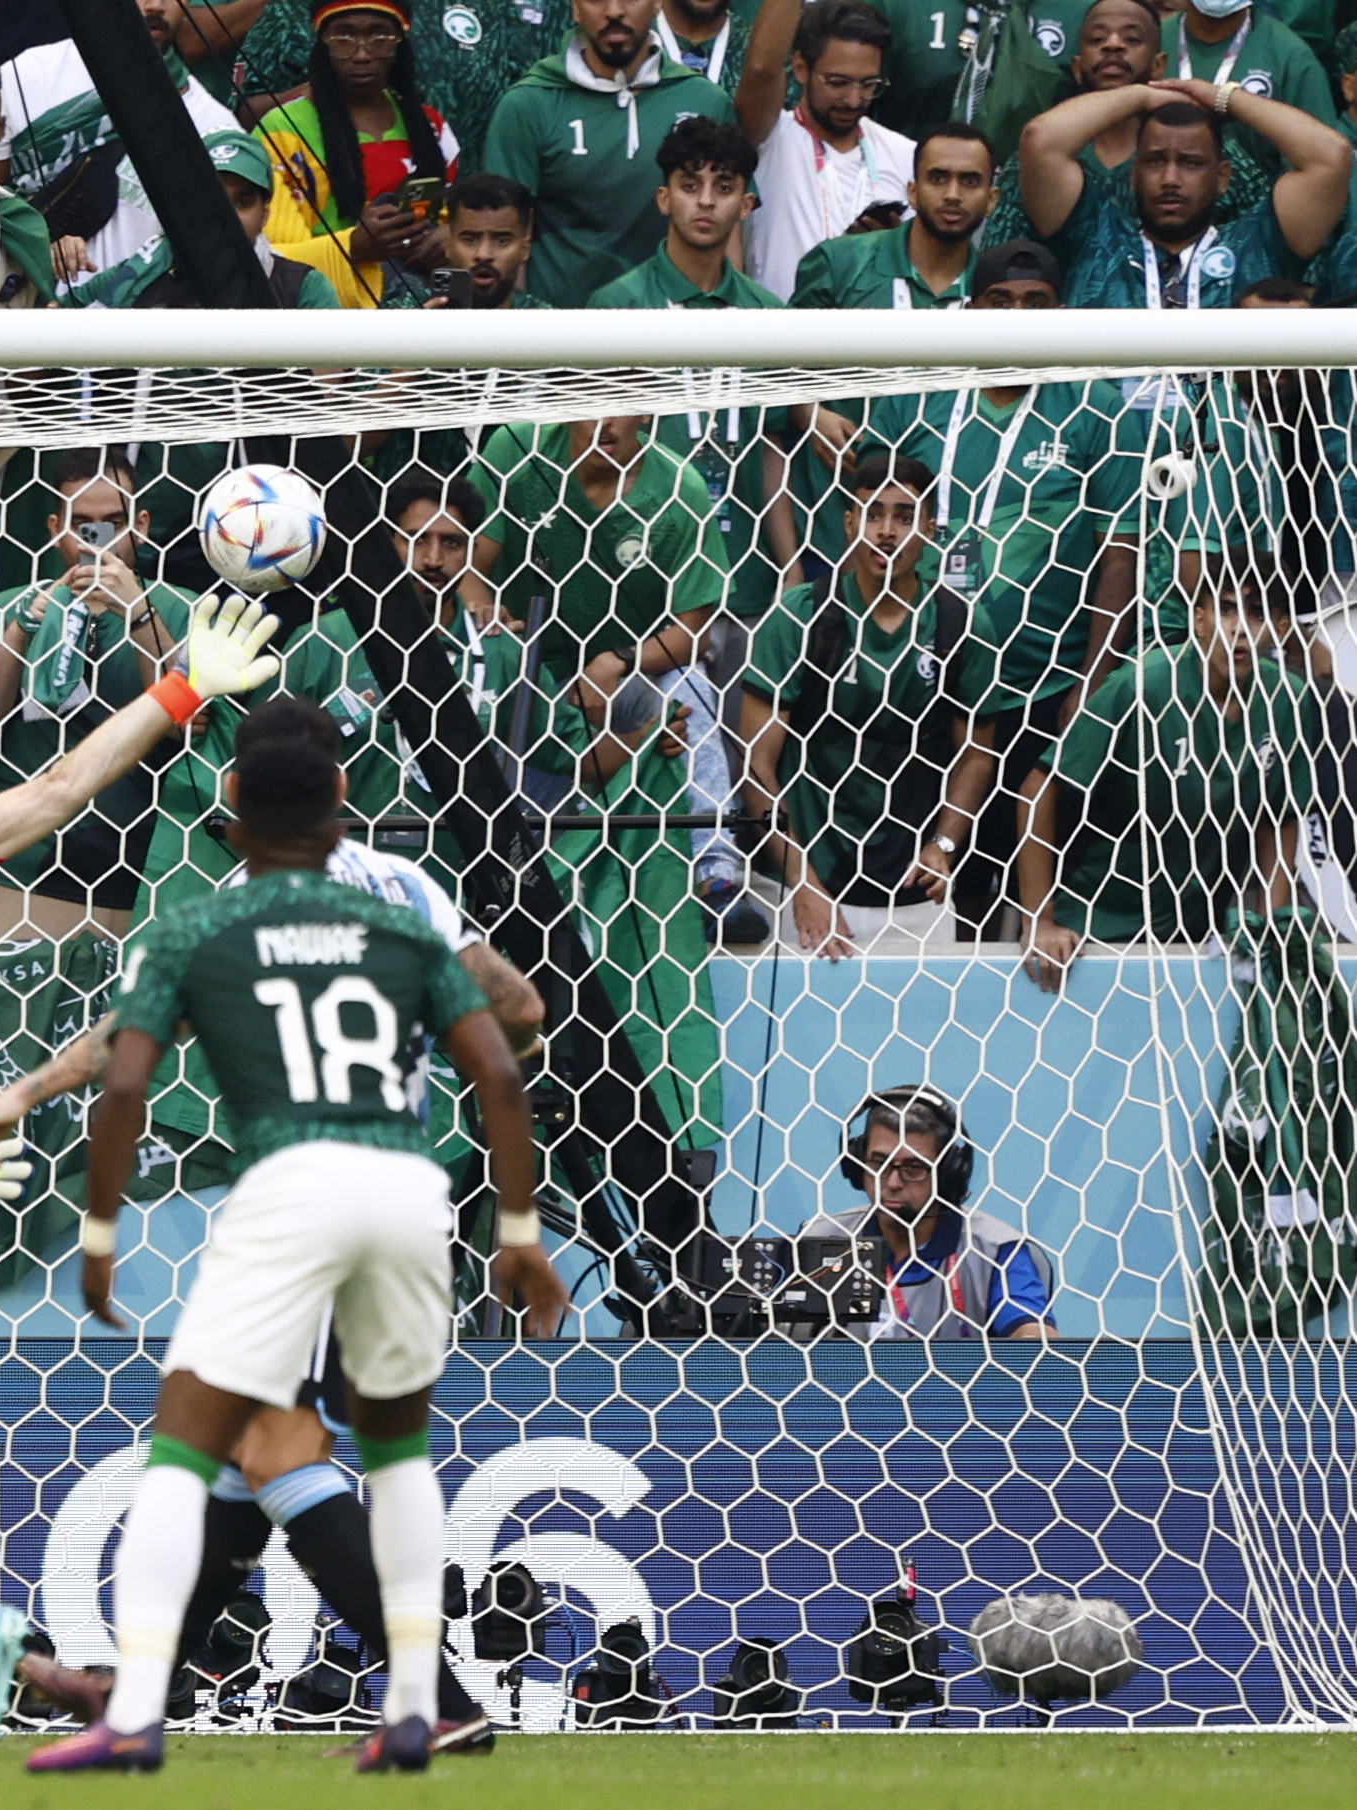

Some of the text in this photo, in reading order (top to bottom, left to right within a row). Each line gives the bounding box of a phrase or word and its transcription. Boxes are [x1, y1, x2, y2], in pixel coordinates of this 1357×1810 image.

[929, 12, 946, 49] 1
[568, 119, 589, 155] 1
[1173, 737, 1189, 776] 1
[253, 922, 368, 967] NAWAF
[252, 975, 407, 1112] 18
[443, 1437, 658, 1730] 6
